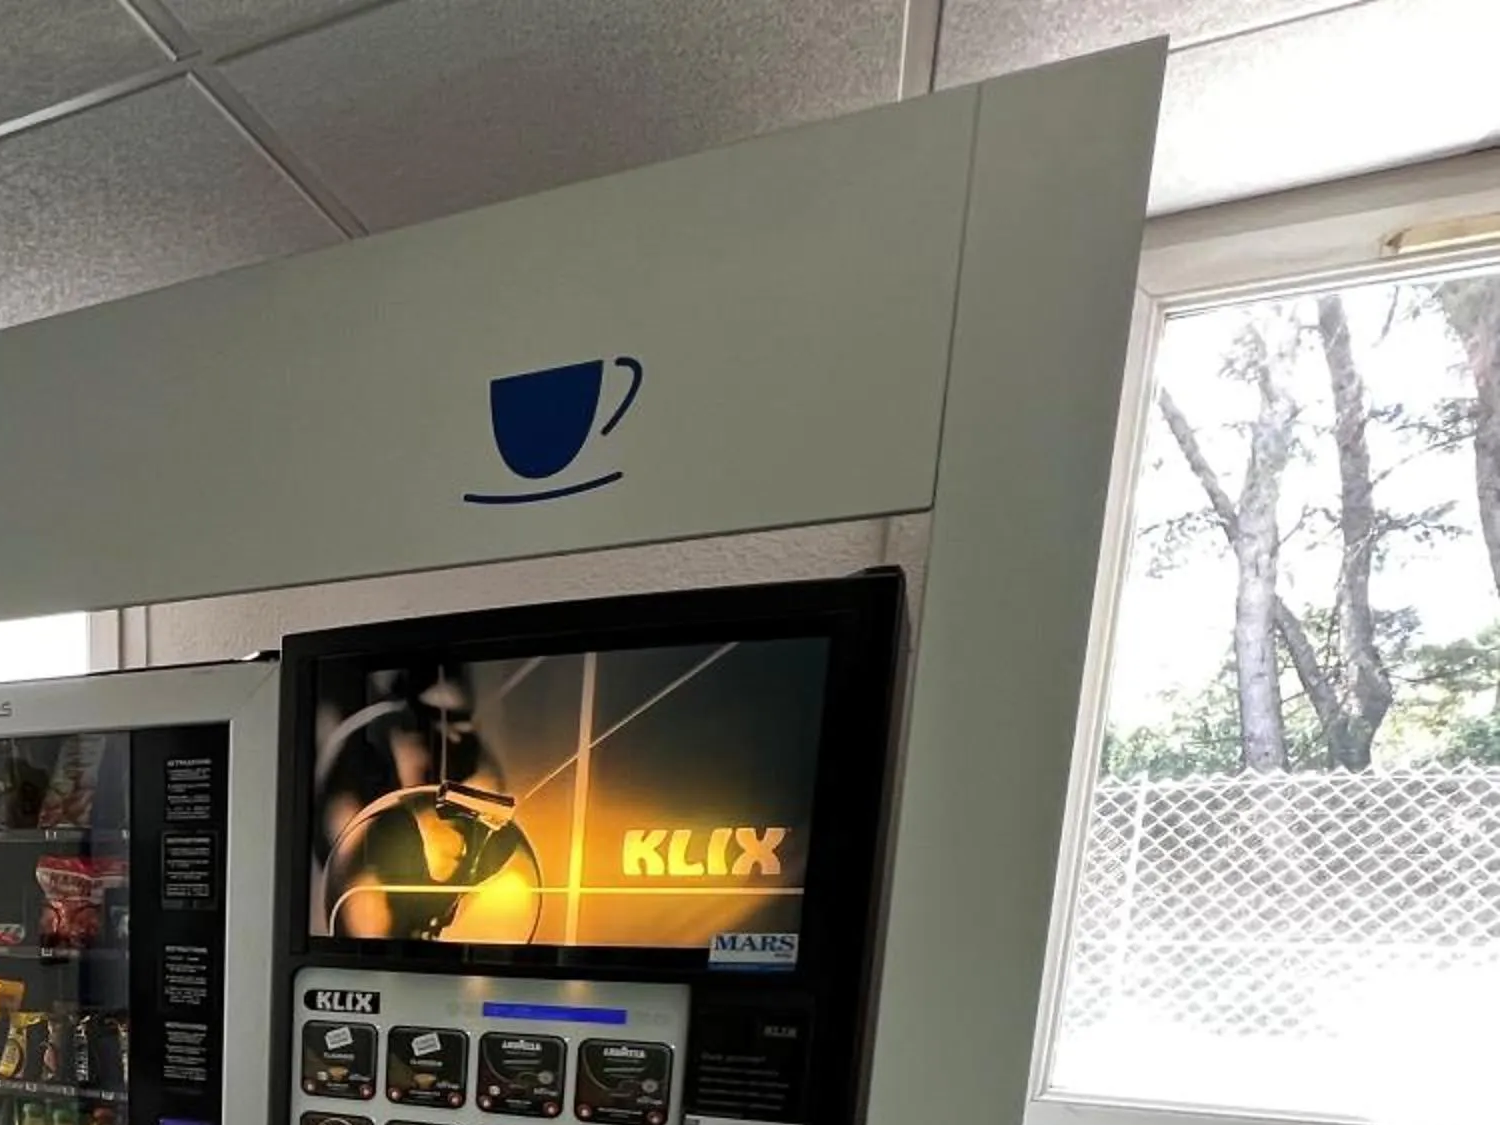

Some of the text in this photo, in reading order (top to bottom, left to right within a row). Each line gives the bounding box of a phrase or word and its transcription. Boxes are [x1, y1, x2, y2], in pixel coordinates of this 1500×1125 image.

[621, 826, 786, 877] KLIX
[715, 935, 795, 952] MARS
[315, 990, 374, 1013] KLIX
